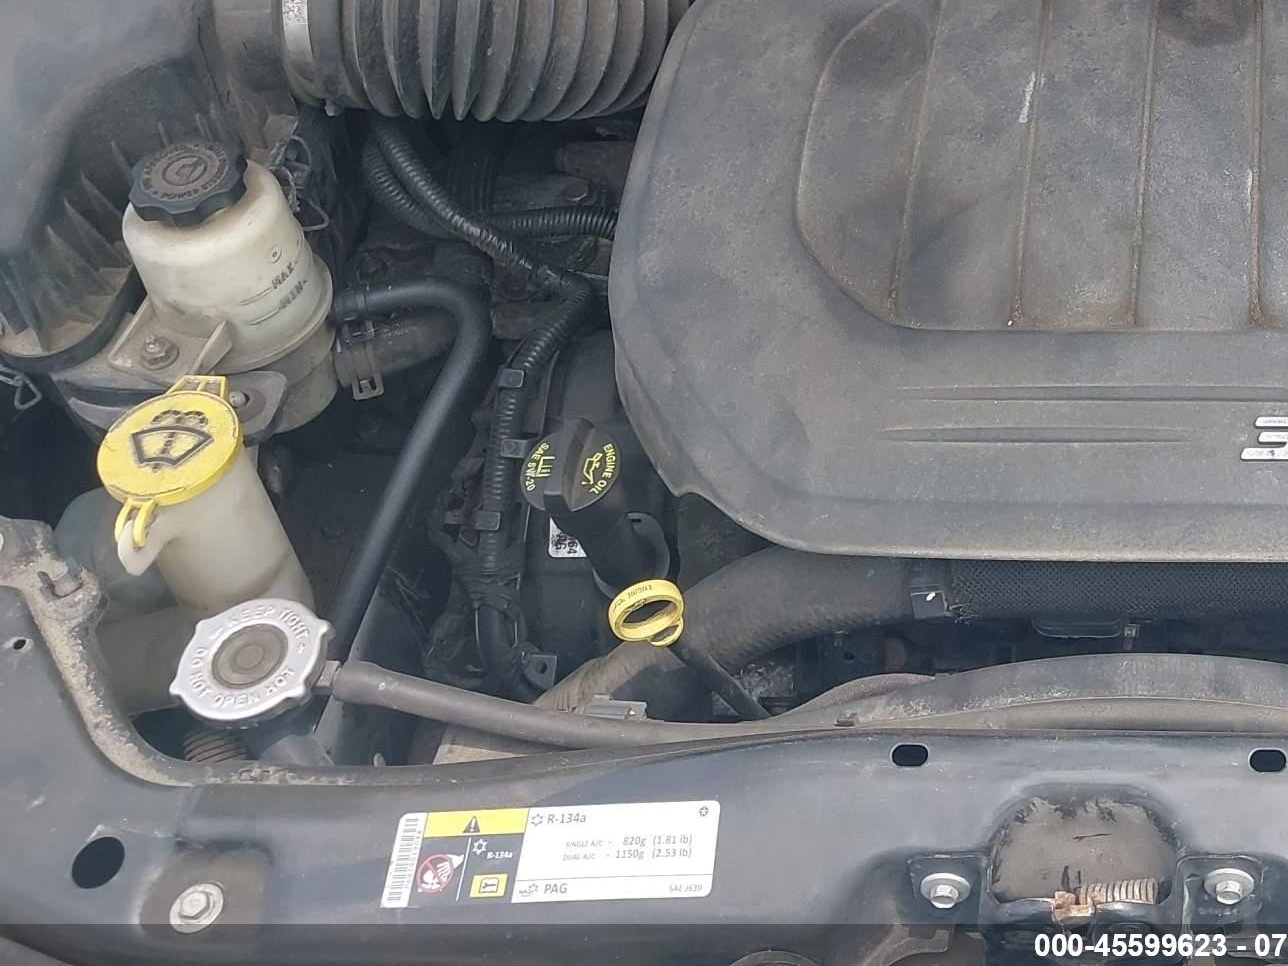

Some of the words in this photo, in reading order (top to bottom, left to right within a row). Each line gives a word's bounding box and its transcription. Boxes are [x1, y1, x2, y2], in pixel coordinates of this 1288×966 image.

[531, 442, 549, 460] SAE
[603, 443, 616, 479] ENGINE
[525, 462, 537, 492] 5W-20
[589, 480, 607, 494] OIL
[191, 646, 209, 668] DO
[190, 671, 213, 699] NOT
[213, 694, 260, 708] OPEN
[547, 812, 588, 825] R-134a
[566, 841, 588, 849] SINGLE
[590, 839, 604, 848] A/C
[622, 835, 647, 848] 820g
[652, 834, 677, 847] (1.81
[680, 834, 693, 846] lb)
[487, 850, 513, 860] R-134a
[563, 853, 581, 862] DUAL
[583, 852, 596, 861] A/C
[615, 848, 644, 860] 1150g
[652, 847, 676, 859] (2.53
[679, 847, 692, 859] lb)
[543, 883, 568, 895] PAG
[684, 883, 703, 893] J639
